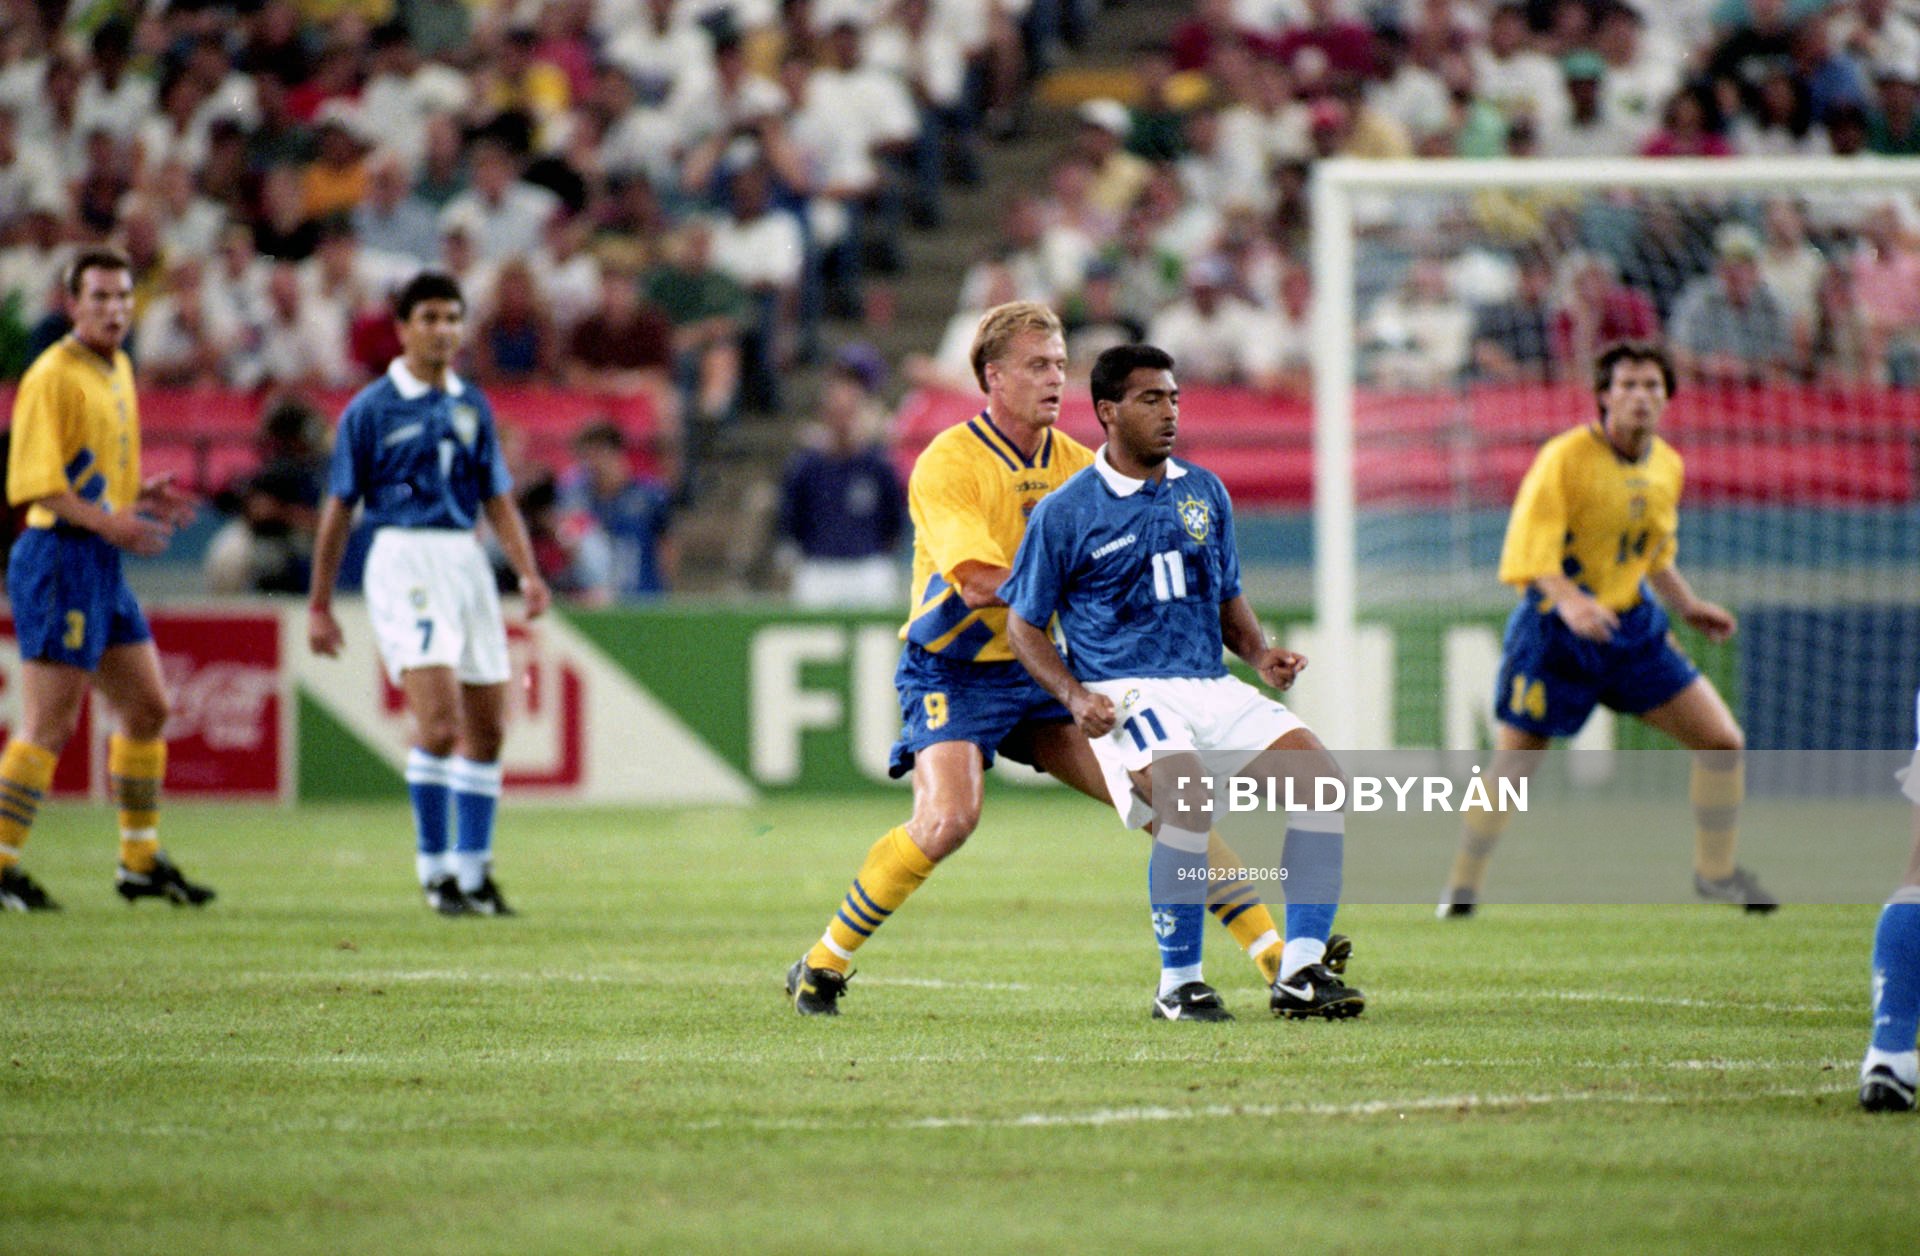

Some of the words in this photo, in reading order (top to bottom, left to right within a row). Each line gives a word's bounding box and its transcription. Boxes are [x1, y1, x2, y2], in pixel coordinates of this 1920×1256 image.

[1091, 533, 1136, 560] UMBRO
[1152, 549, 1187, 601] 11
[63, 609, 86, 650] 3
[416, 619, 434, 654] 7
[923, 692, 949, 730] 9
[1510, 674, 1547, 721] 14
[1123, 707, 1168, 752] 11
